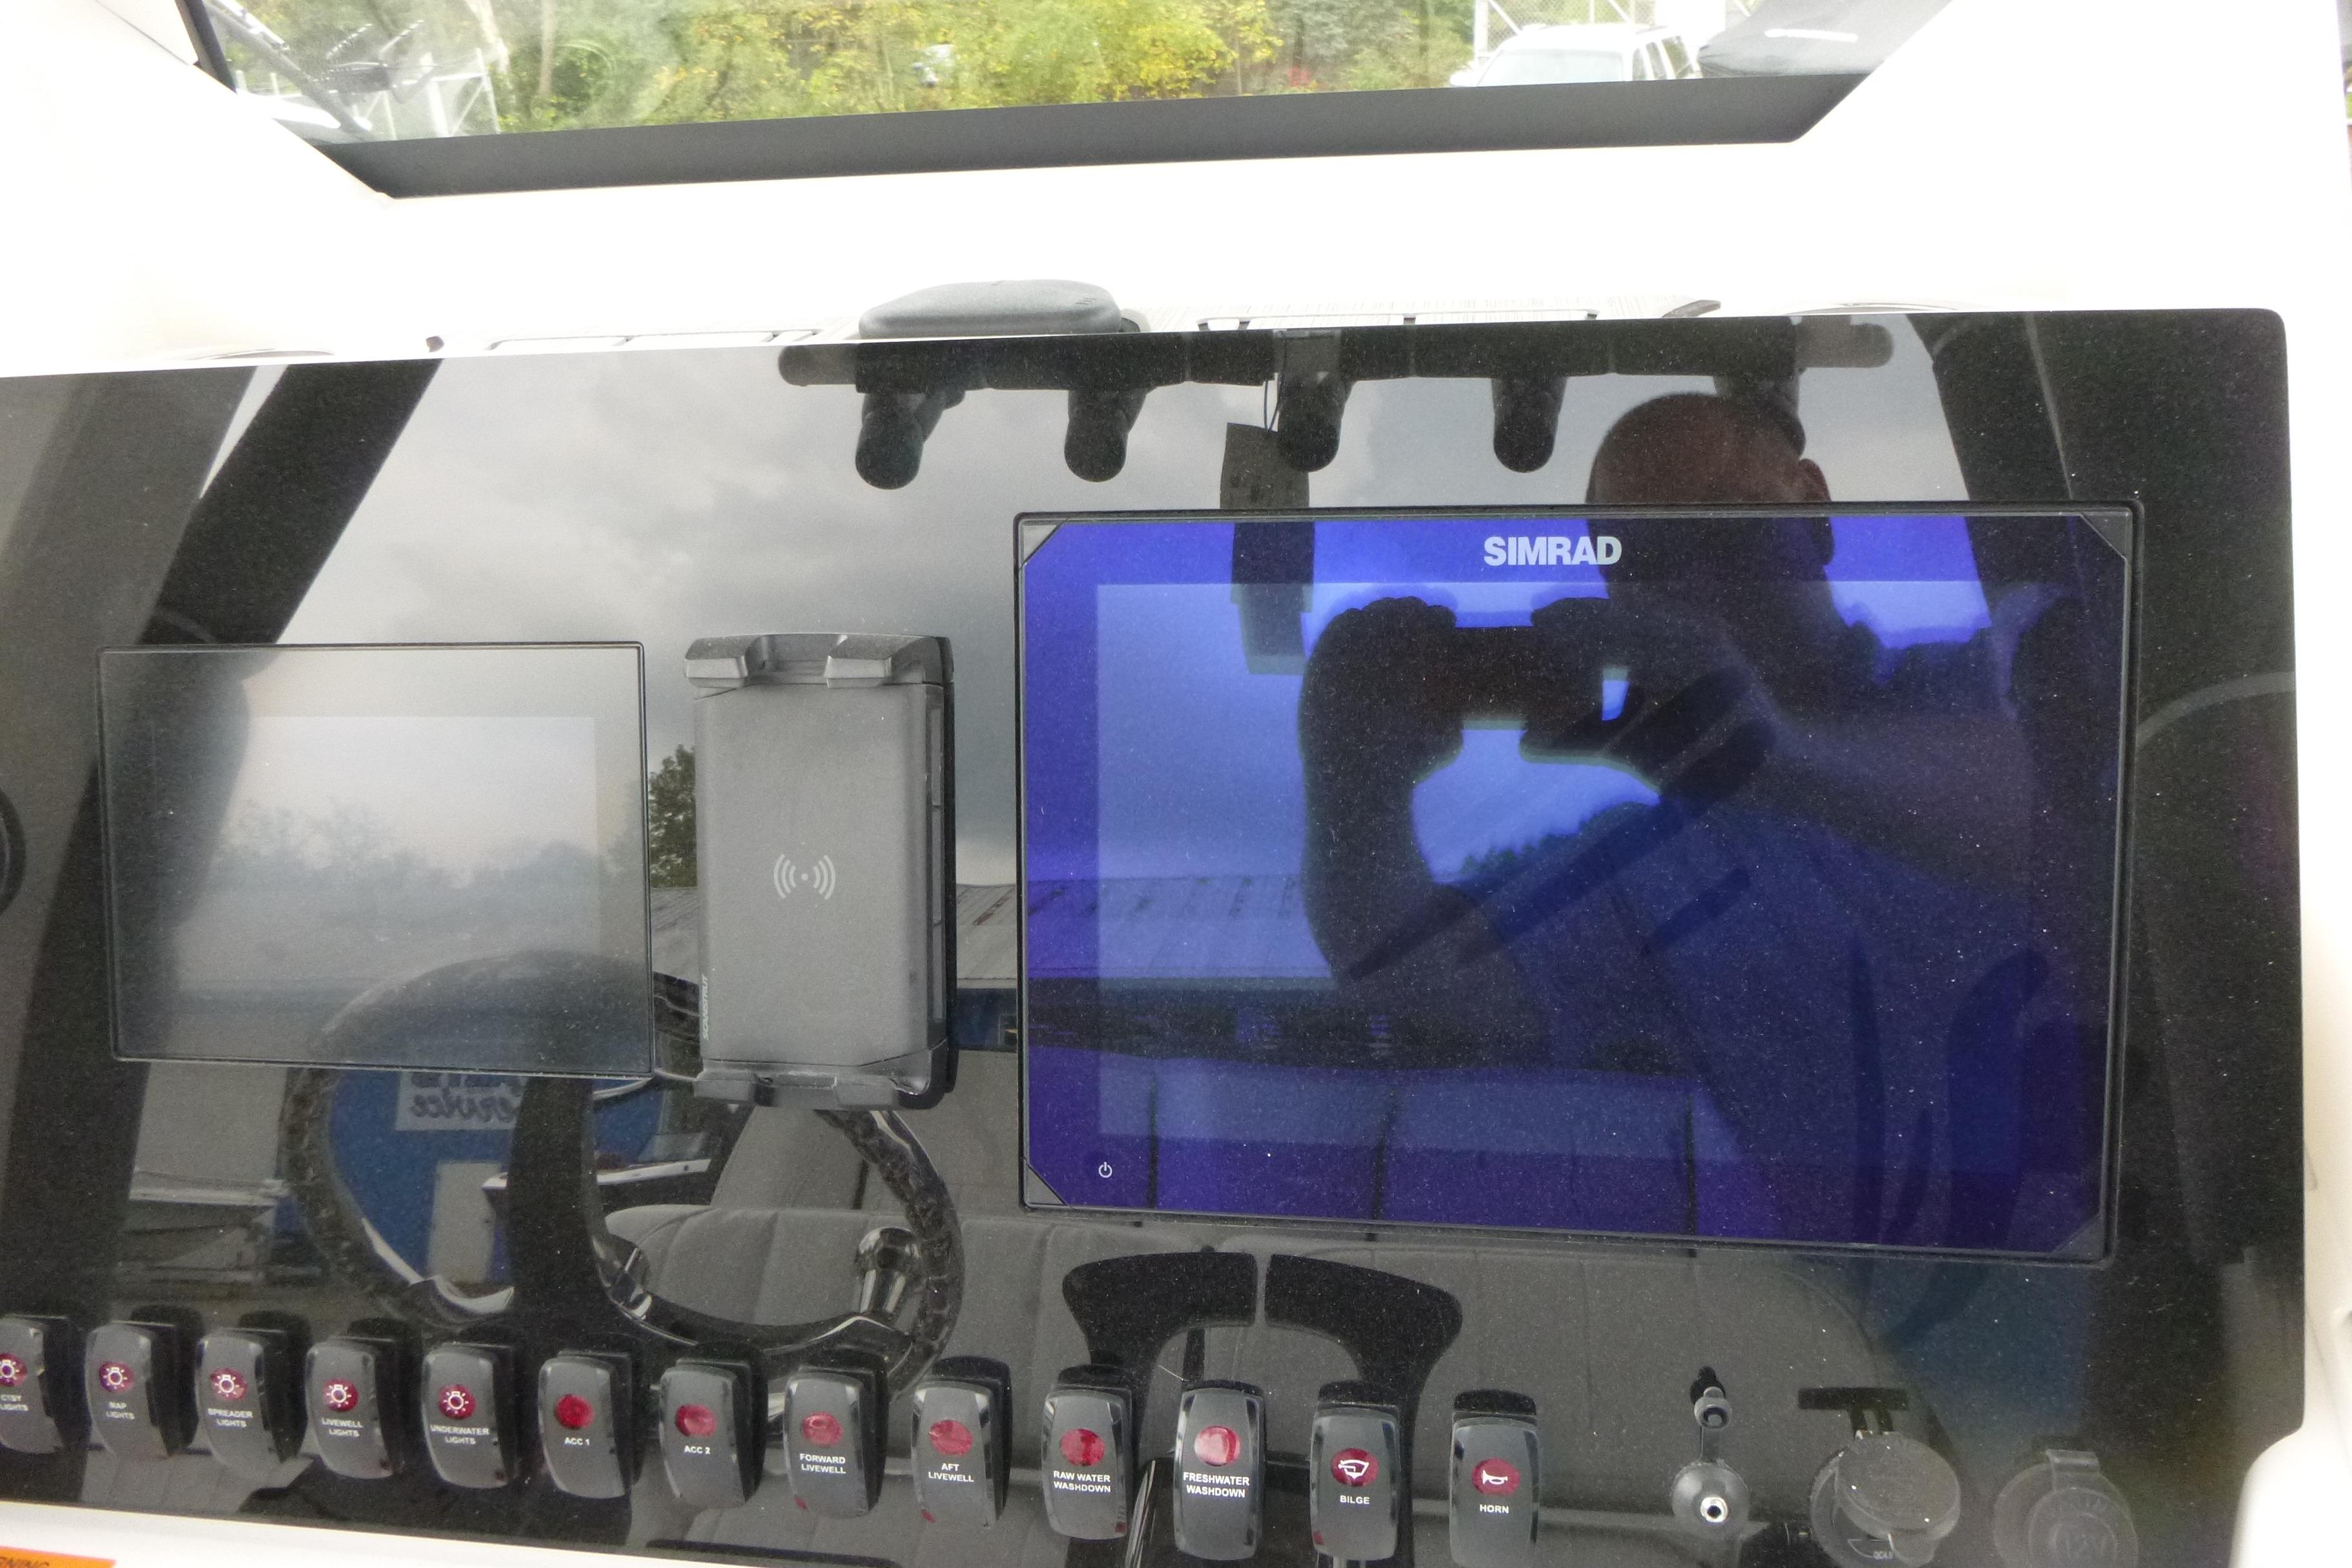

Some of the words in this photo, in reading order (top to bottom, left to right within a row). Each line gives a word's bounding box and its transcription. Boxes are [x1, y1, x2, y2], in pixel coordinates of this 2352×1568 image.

[1484, 536, 1622, 566] SIMRAD
[106, 1411, 134, 1420] LIGHTS
[208, 1407, 253, 1418] SPREADER
[217, 1419, 246, 1427] LIGHTS
[322, 1418, 363, 1428] LIVEWELL
[329, 1429, 359, 1437] LIGHTS
[430, 1424, 489, 1435] UNDERWATER
[445, 1436, 476, 1445] LIGHTS
[564, 1437, 583, 1446] ACC
[684, 1445, 703, 1454] ACC
[799, 1453, 846, 1464] FORWARD
[801, 1463, 847, 1474] LIVEWELL
[941, 1463, 959, 1471] AFT
[928, 1471, 974, 1482] LIVEWELL
[1053, 1470, 1075, 1480] RAW
[1077, 1473, 1111, 1482] WATER
[1183, 1471, 1250, 1485] FRESHWATER
[1054, 1480, 1111, 1493] WASHDOWN
[1186, 1484, 1246, 1498] WASHDOWN
[1340, 1494, 1370, 1505] BILGE
[1479, 1504, 1509, 1514] HORN
